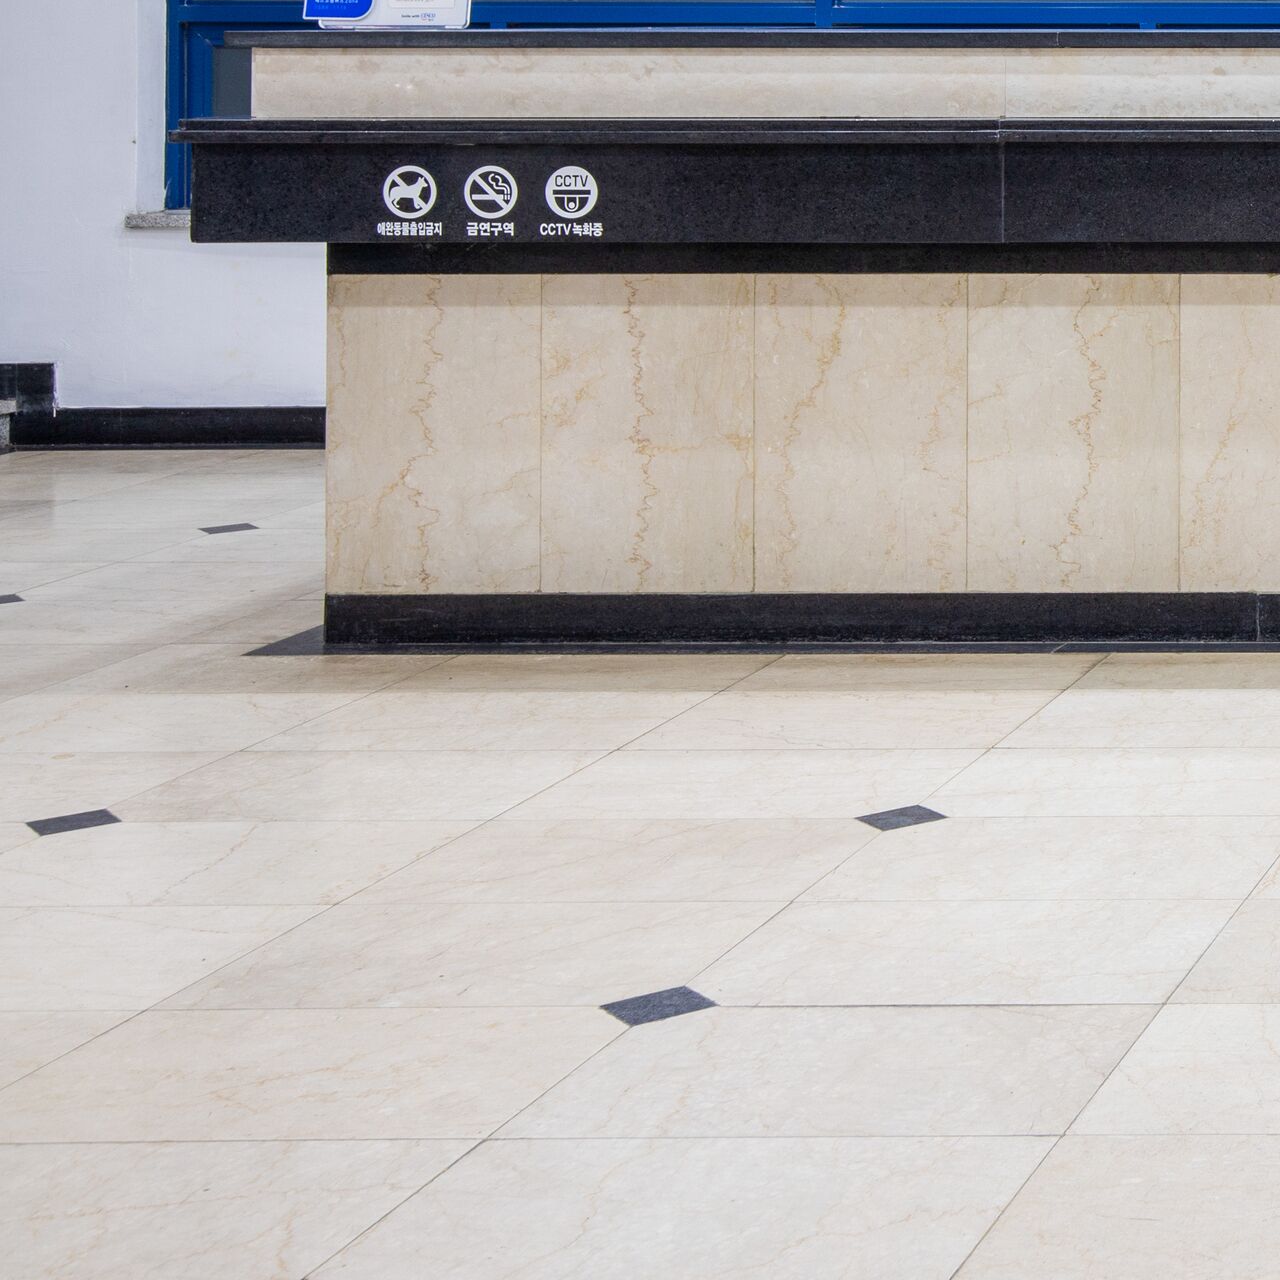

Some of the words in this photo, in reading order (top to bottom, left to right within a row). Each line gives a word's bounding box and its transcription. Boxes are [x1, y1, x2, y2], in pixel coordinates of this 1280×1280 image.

[554, 174, 589, 188] CCTV
[376, 222, 443, 236] 애완동물출입금지
[466, 222, 515, 237] 금연구역
[539, 223, 571, 236] CCTV
[572, 222, 604, 237] 녹화중
